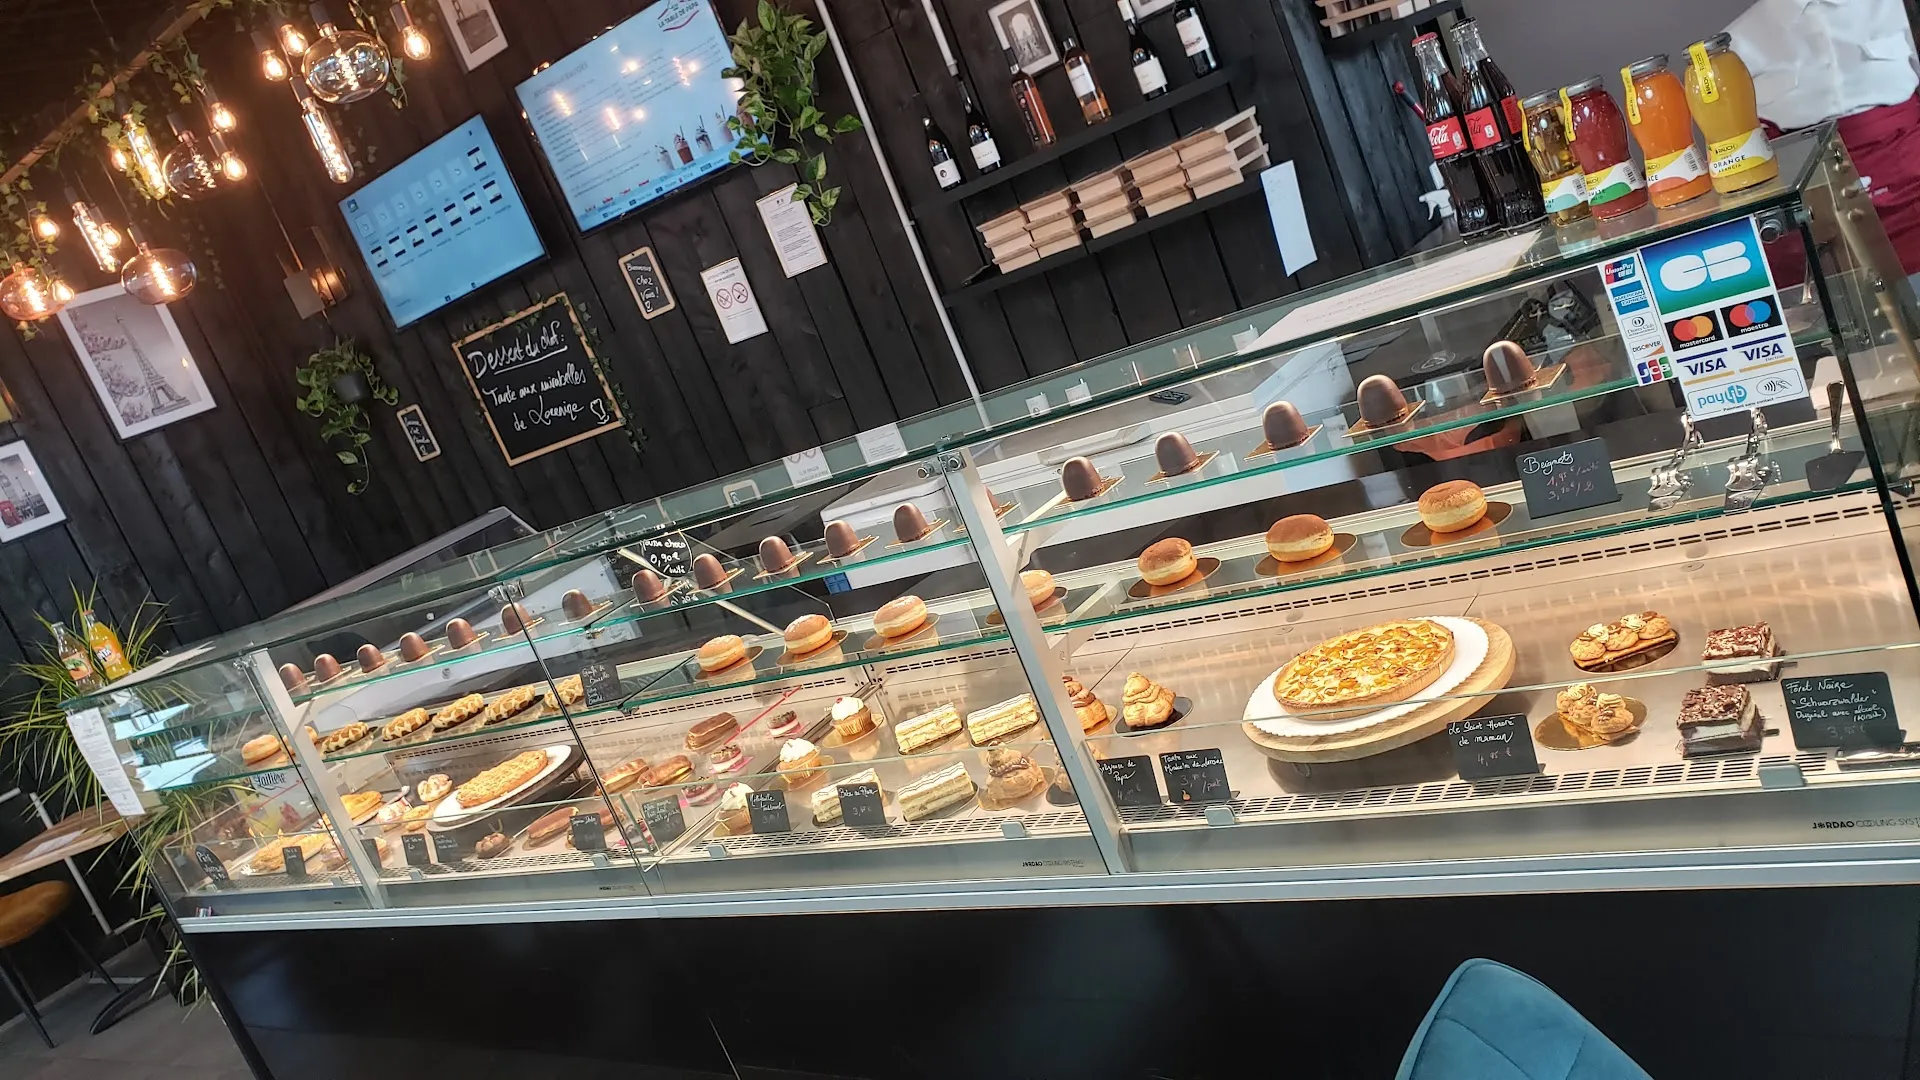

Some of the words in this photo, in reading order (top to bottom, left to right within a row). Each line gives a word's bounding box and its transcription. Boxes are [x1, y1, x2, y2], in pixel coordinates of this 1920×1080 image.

[1713, 154, 1746, 169] ORANGE
[1606, 263, 1634, 276] UnionPay
[1614, 290, 1645, 302] AMERICAN
[1620, 295, 1648, 307] EXPRESS
[1740, 322, 1769, 334] maestro
[1632, 340, 1662, 353] DISCOVER
[1680, 335, 1716, 348] mastercard
[467, 337, 524, 379] Dessert
[525, 332, 541, 358] du
[1743, 343, 1784, 362] VISA
[1684, 357, 1727, 376] VISA
[482, 385, 517, 407] Tarte
[519, 383, 537, 399] aux
[541, 362, 587, 392] mirabelles
[513, 412, 528, 432] de
[1523, 450, 1574, 476] Beignets
[1463, 720, 1483, 732] Saint
[1458, 736, 1470, 746] de
